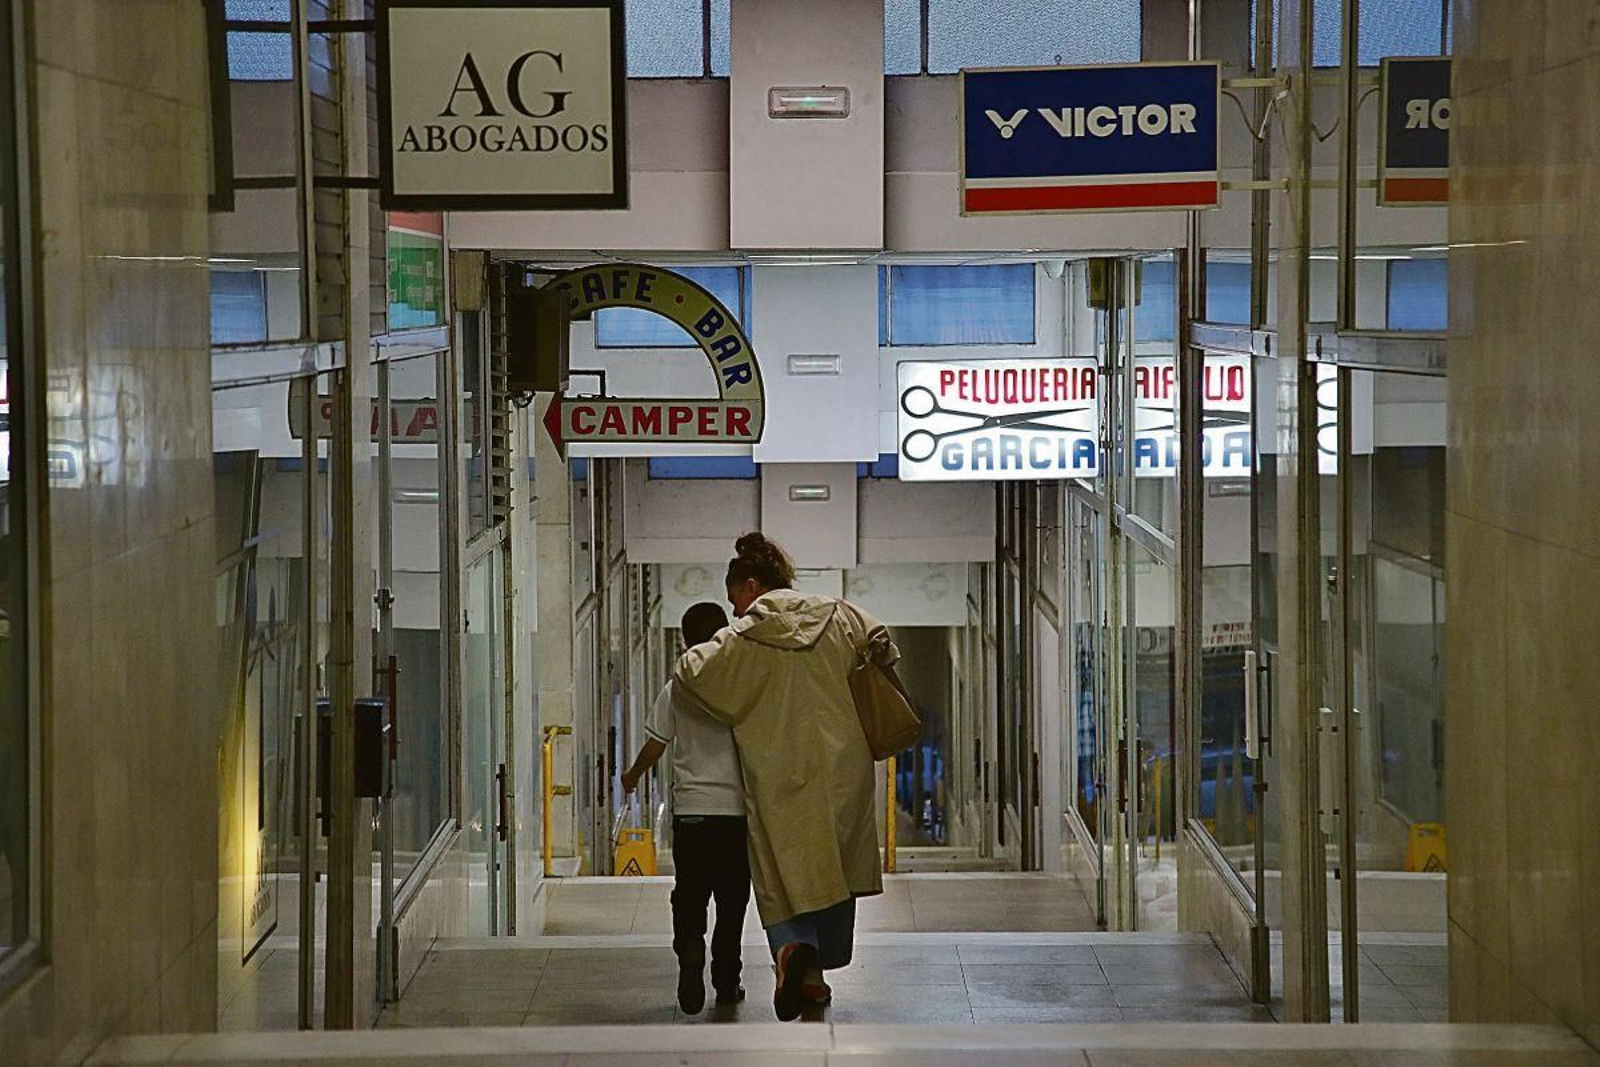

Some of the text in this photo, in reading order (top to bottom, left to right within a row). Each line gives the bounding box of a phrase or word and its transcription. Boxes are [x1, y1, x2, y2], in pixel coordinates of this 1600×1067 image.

[437, 50, 574, 118] AG
[397, 124, 608, 152] ABOGADOS
[1037, 103, 1197, 137] VICTOR
[693, 307, 753, 390] BAR
[940, 367, 1096, 404] PELUQUERIA
[571, 405, 752, 437] CAMPER
[941, 434, 1096, 471] GARCIA
